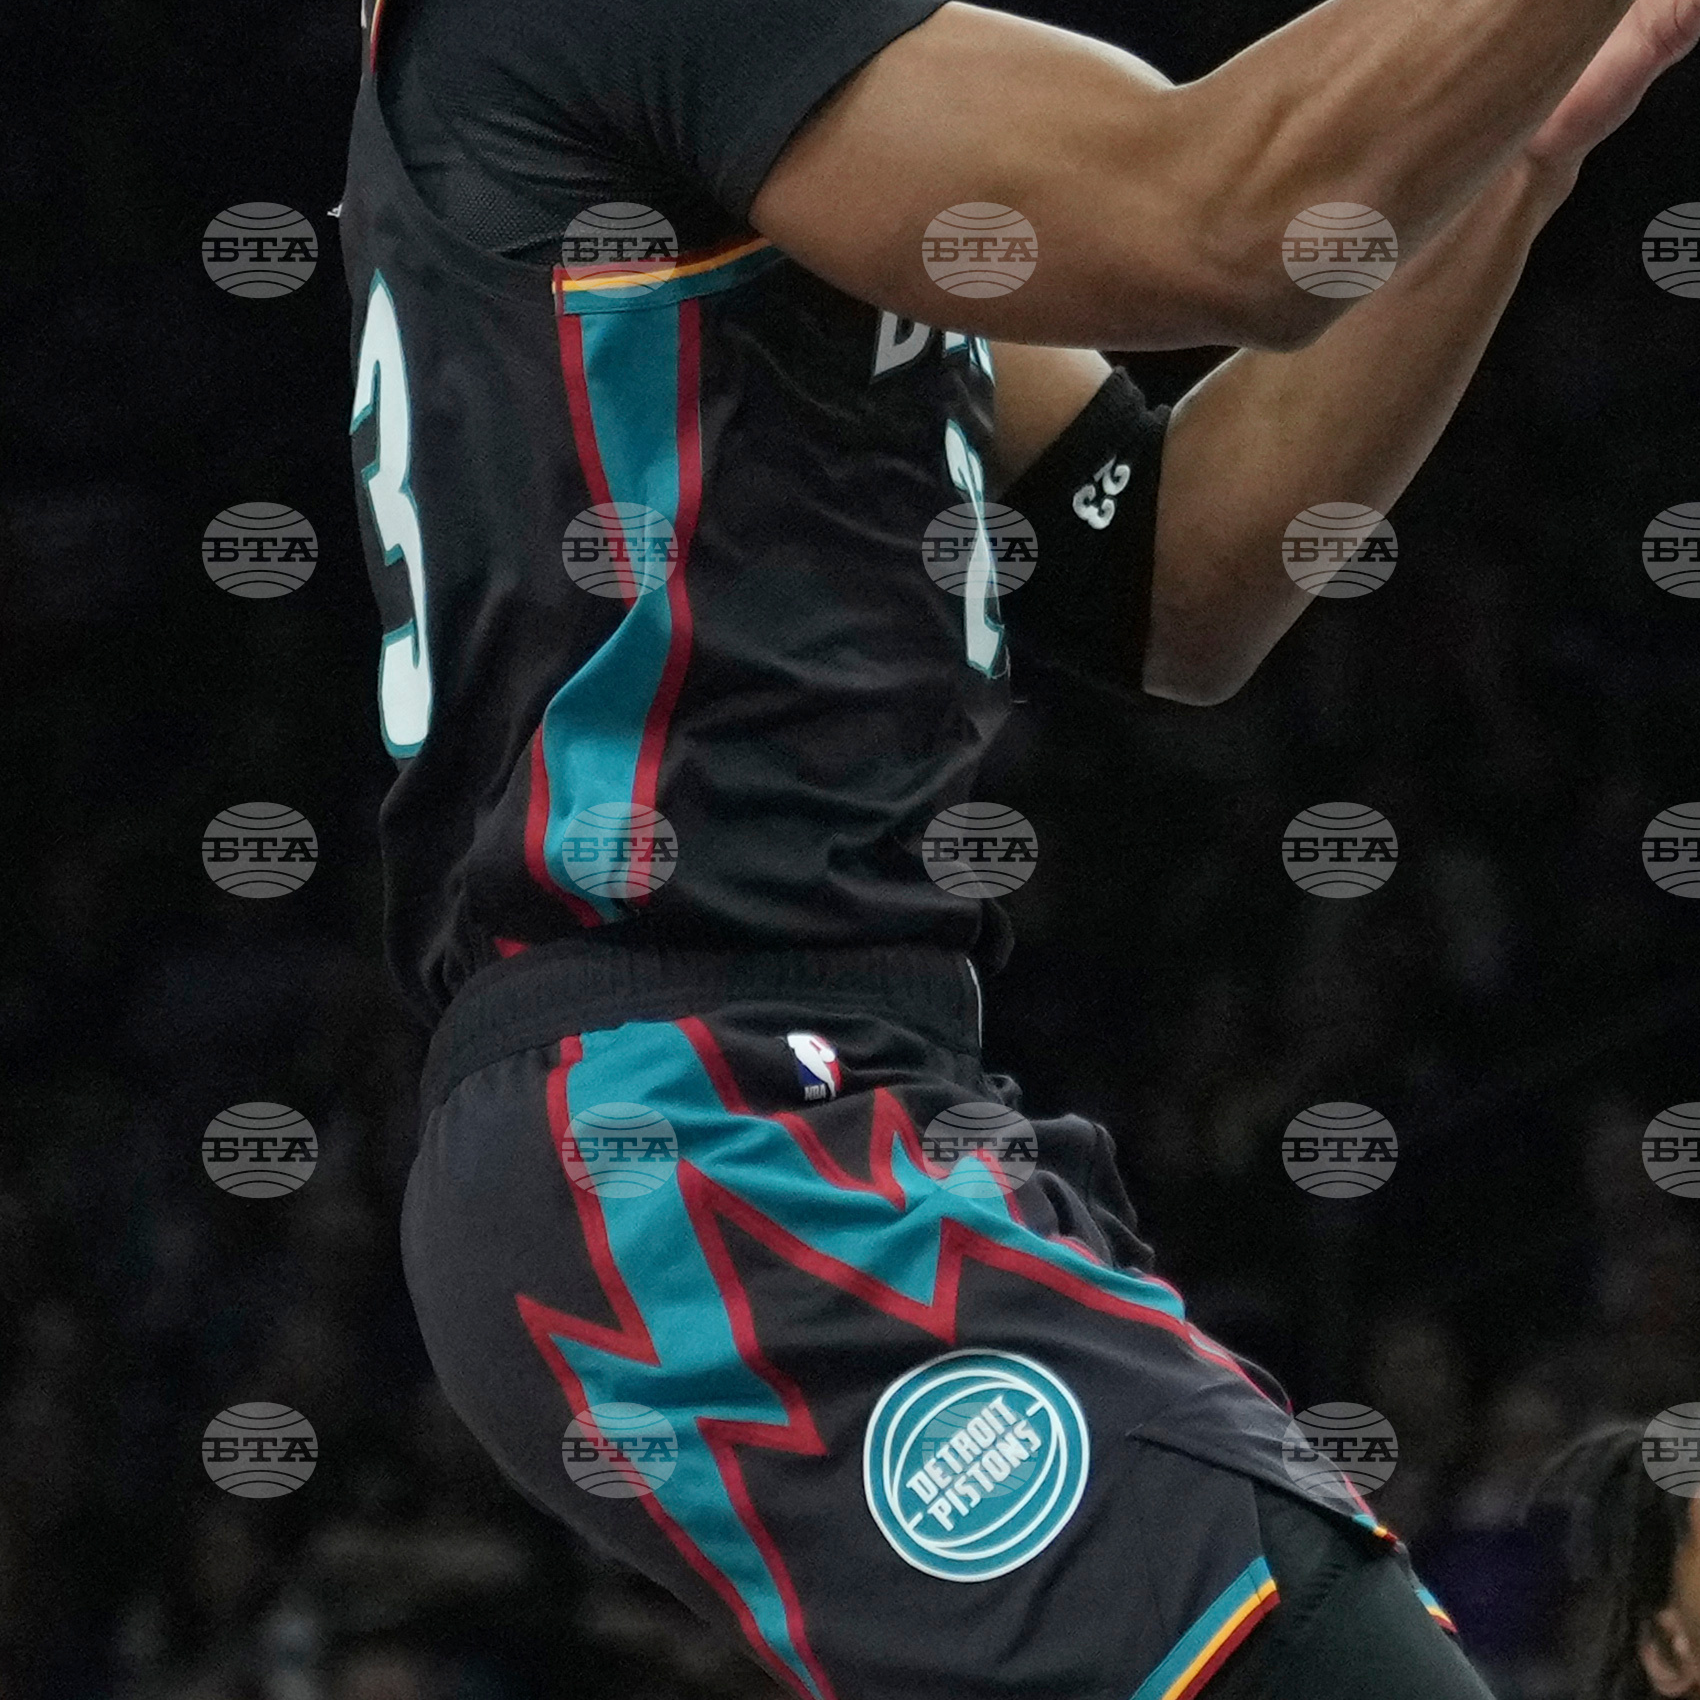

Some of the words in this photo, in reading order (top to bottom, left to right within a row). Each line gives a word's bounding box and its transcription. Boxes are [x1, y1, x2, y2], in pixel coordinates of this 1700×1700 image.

[1072, 454, 1131, 530] 23
[906, 1394, 1017, 1505] DETROIT
[927, 1419, 1043, 1532] PISTONS
